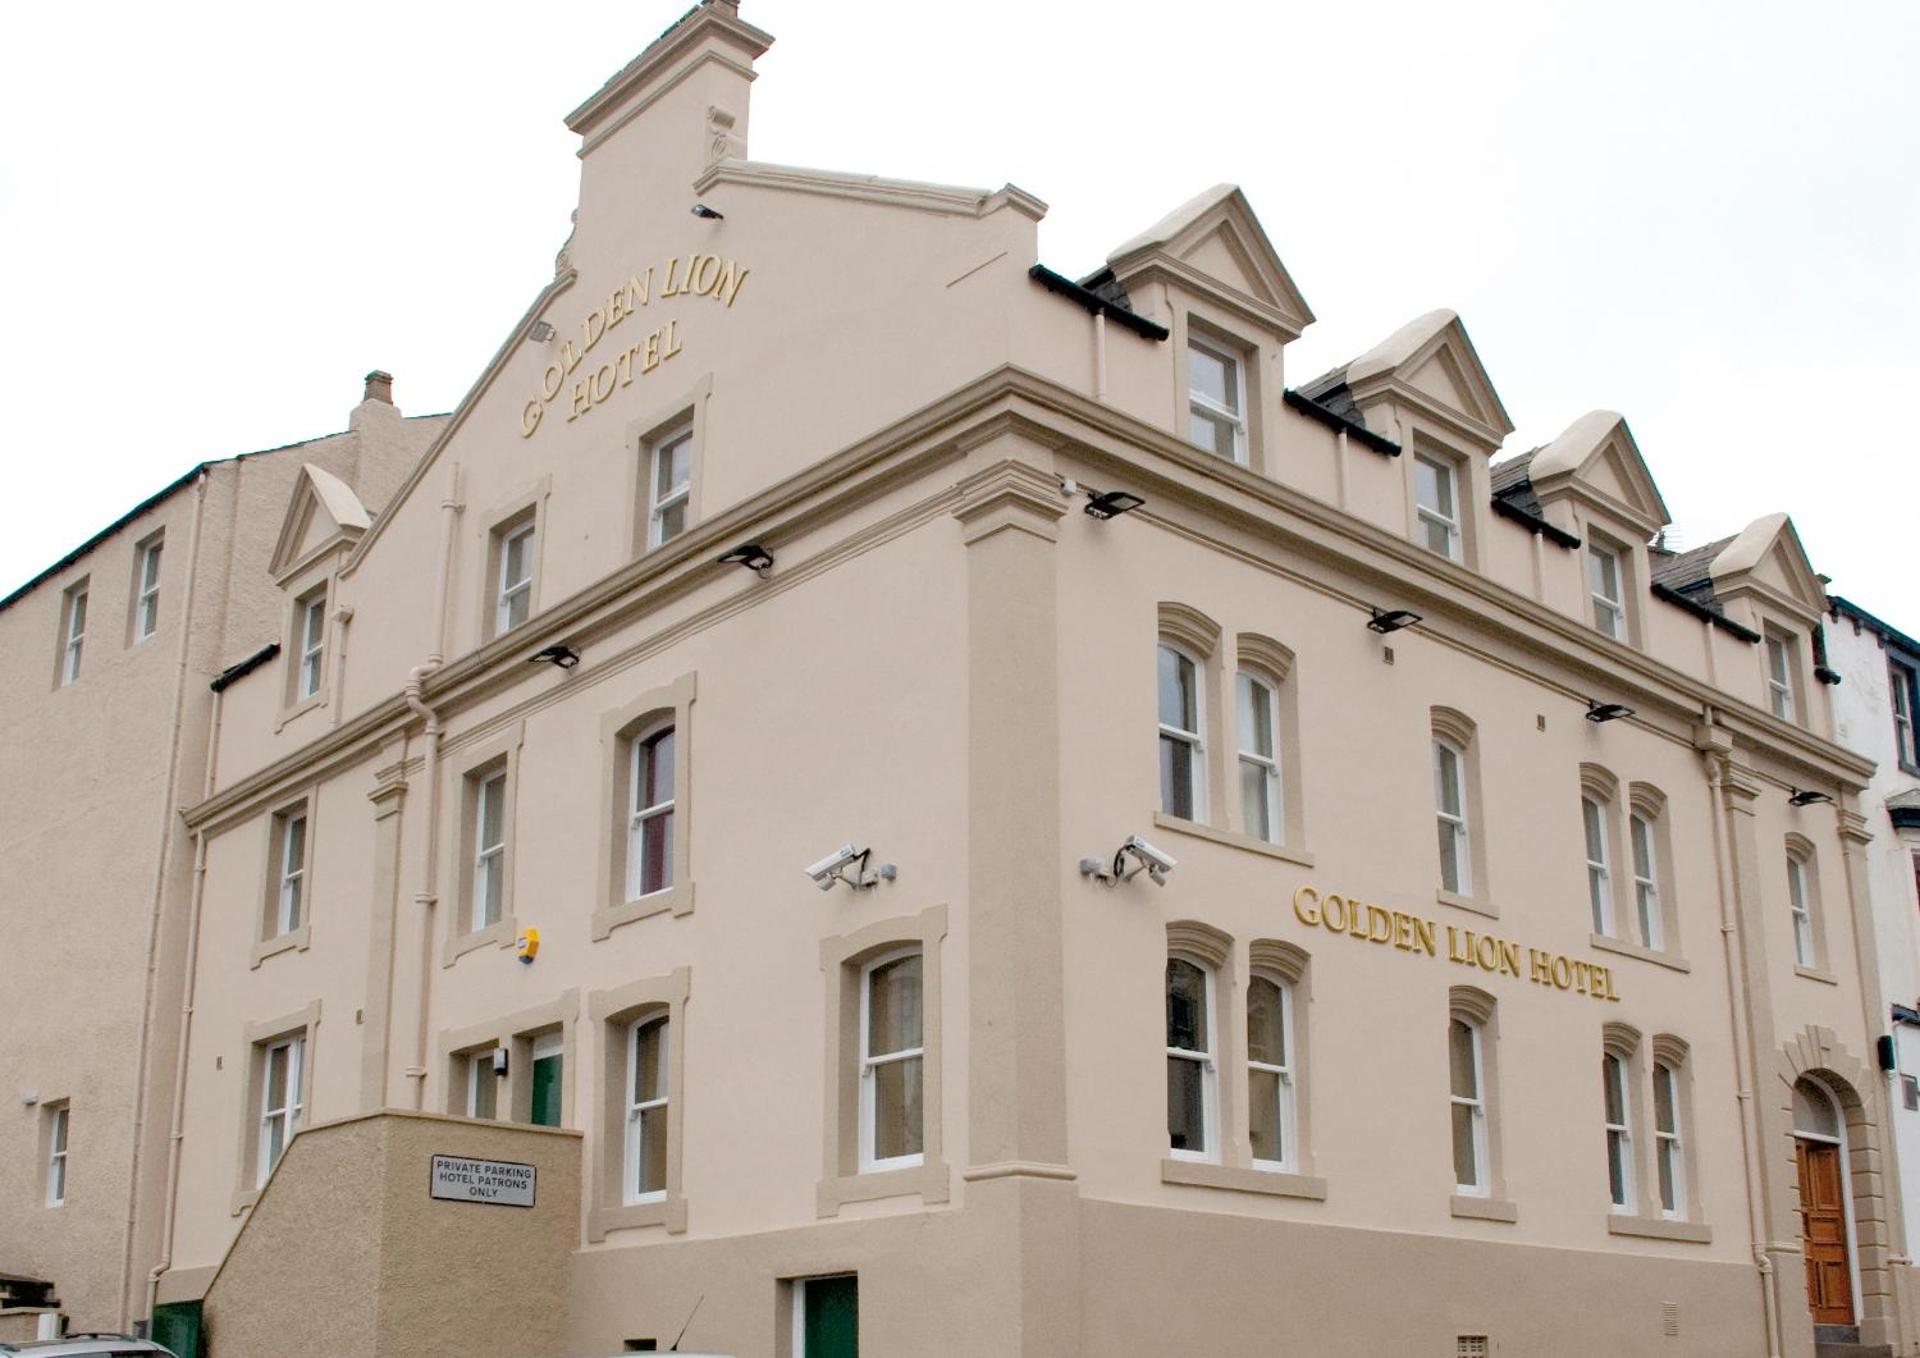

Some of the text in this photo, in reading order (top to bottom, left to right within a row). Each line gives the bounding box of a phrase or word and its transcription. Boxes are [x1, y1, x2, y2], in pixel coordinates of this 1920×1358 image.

[522, 253, 750, 439] GOLDEN LION
[566, 318, 683, 423] HOTEL
[1294, 886, 1620, 1002] GOLDEN LION HOTEL
[437, 1160, 532, 1179] PRIVATE PARKING
[440, 1172, 528, 1190] HOTEL PATRONS
[469, 1186, 499, 1198] ONLY
